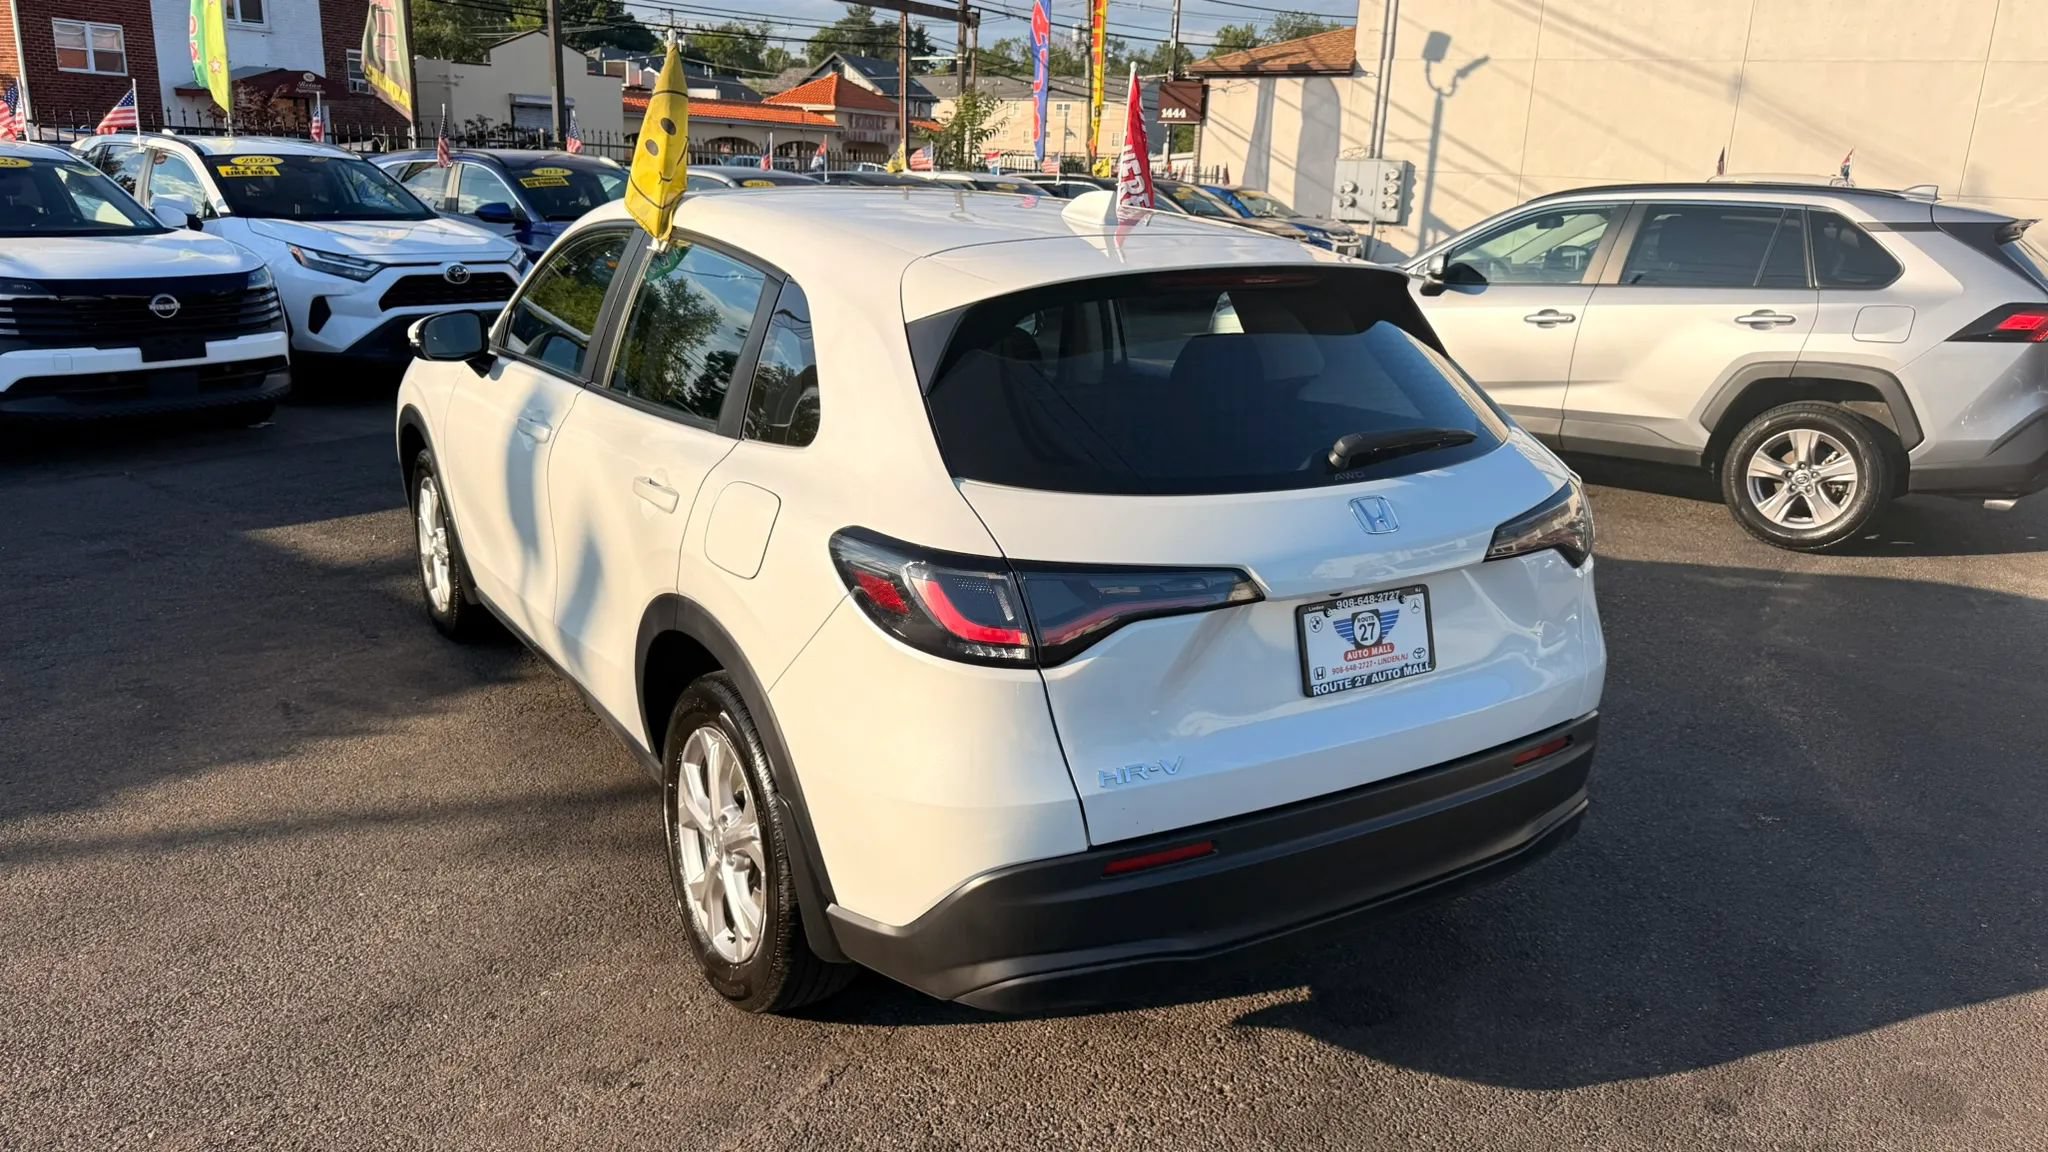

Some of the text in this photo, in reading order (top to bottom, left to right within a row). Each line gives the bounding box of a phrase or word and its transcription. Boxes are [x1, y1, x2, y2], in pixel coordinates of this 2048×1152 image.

[1161, 107, 1187, 119] 1444
[1334, 470, 1366, 481] AWD
[1336, 590, 1401, 610] 908-648-2727
[1356, 614, 1375, 623] ROUTE
[1358, 622, 1376, 642] 27
[1346, 644, 1393, 660] AUTO MALL
[1331, 660, 1373, 675] 908-648-2727
[1312, 662, 1432, 696] ROUTE 27 AUTO MALL
[1097, 754, 1185, 788] HR-V
